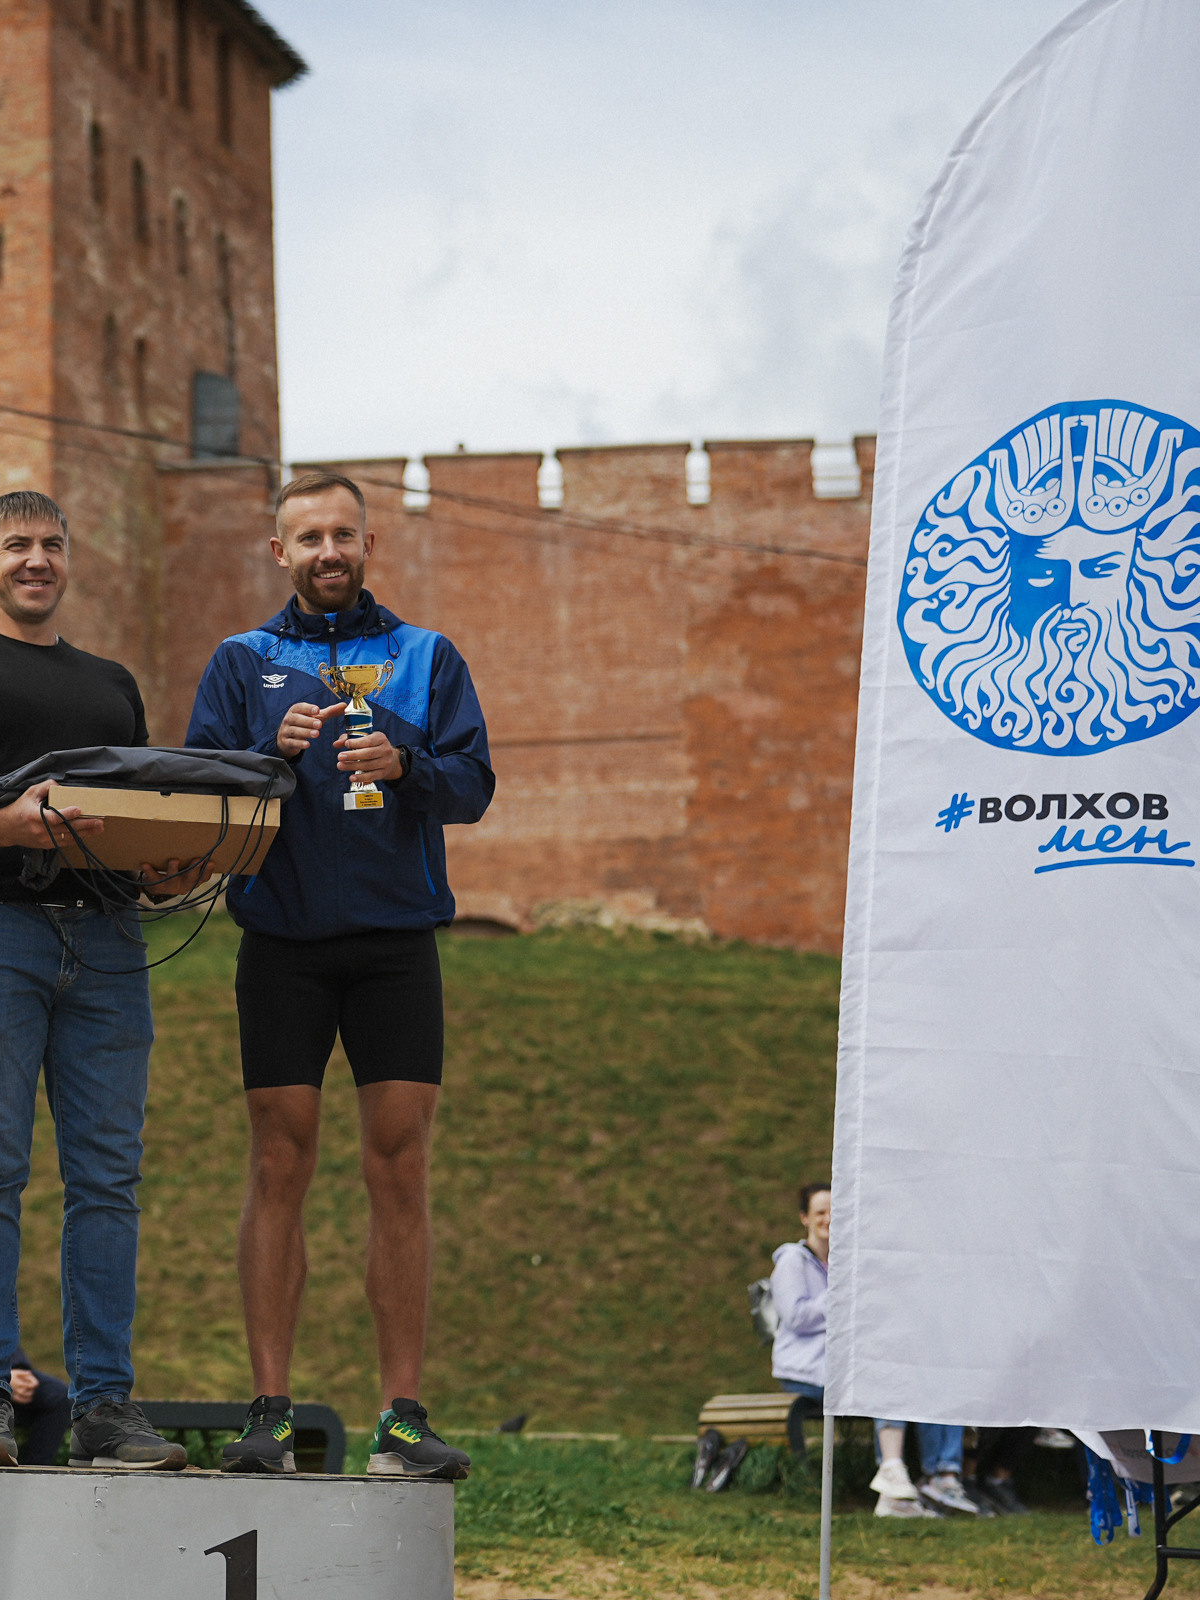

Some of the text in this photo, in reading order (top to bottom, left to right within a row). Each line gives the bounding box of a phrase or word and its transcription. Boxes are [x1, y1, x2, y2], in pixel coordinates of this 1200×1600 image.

[935, 792, 1169, 833] #ВОЛХОВ
[1038, 824, 1191, 855] мен
[203, 1529, 258, 1600] 1
